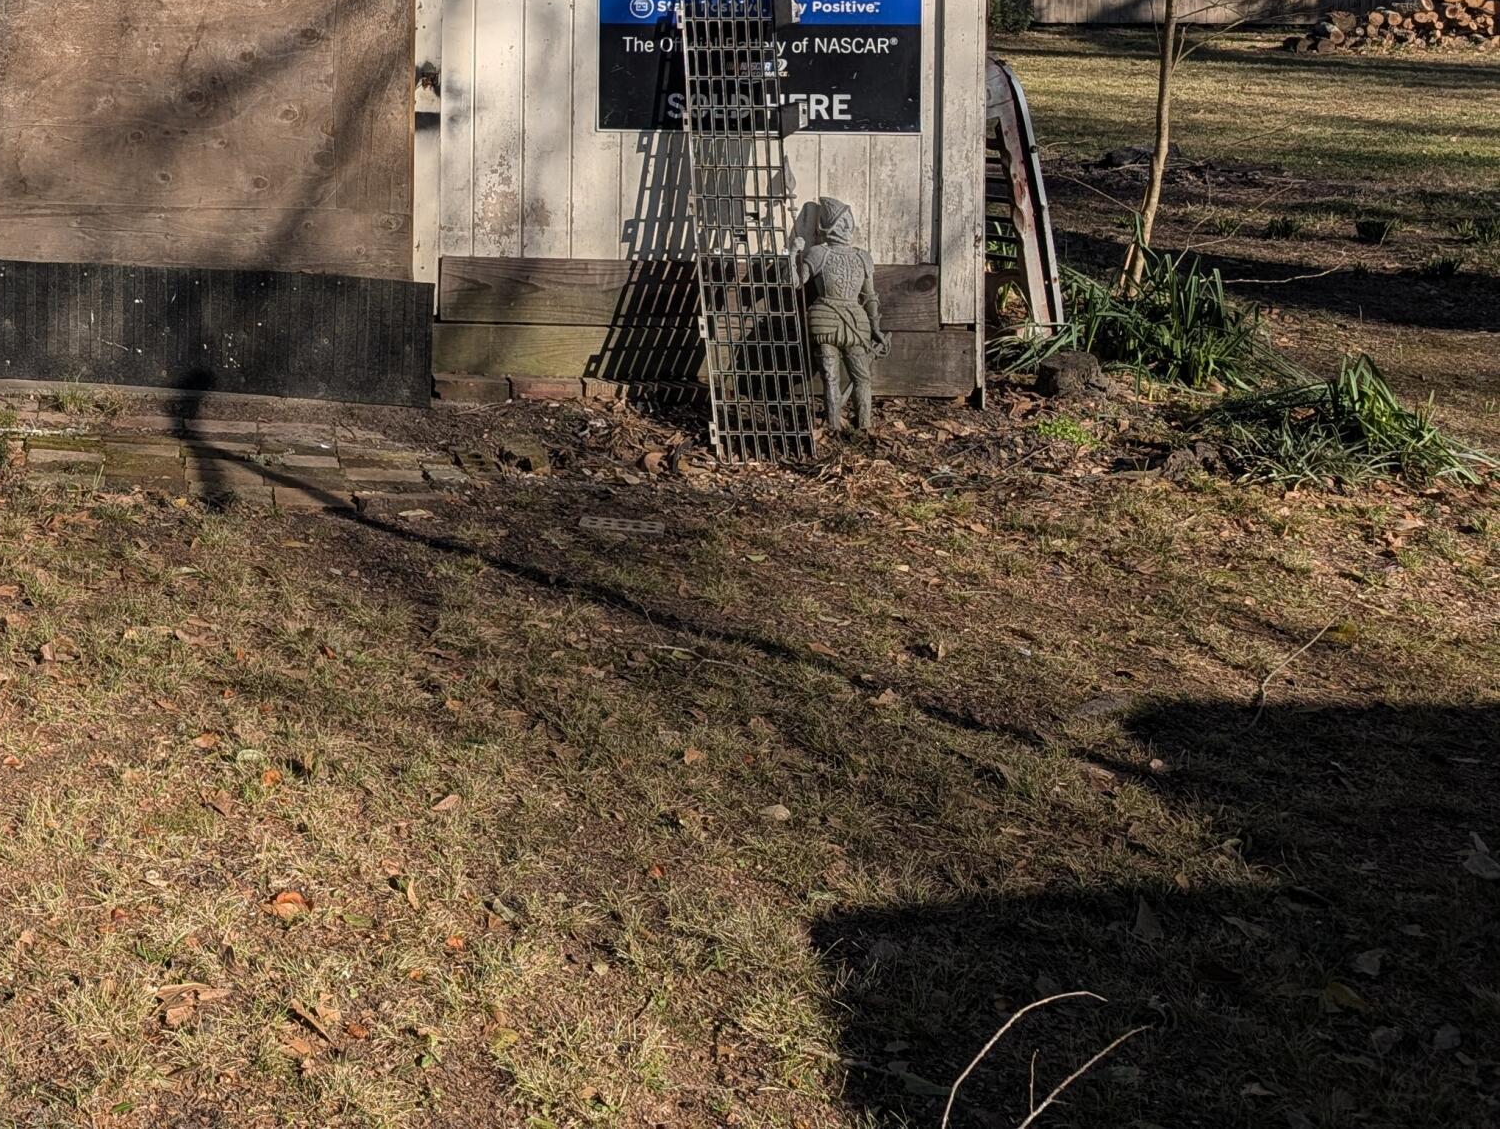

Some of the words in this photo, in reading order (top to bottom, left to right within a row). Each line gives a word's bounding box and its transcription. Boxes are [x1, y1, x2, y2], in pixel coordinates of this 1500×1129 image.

[622, 36, 654, 53] The
[791, 36, 809, 53] of
[667, 94, 750, 119] SOLD
